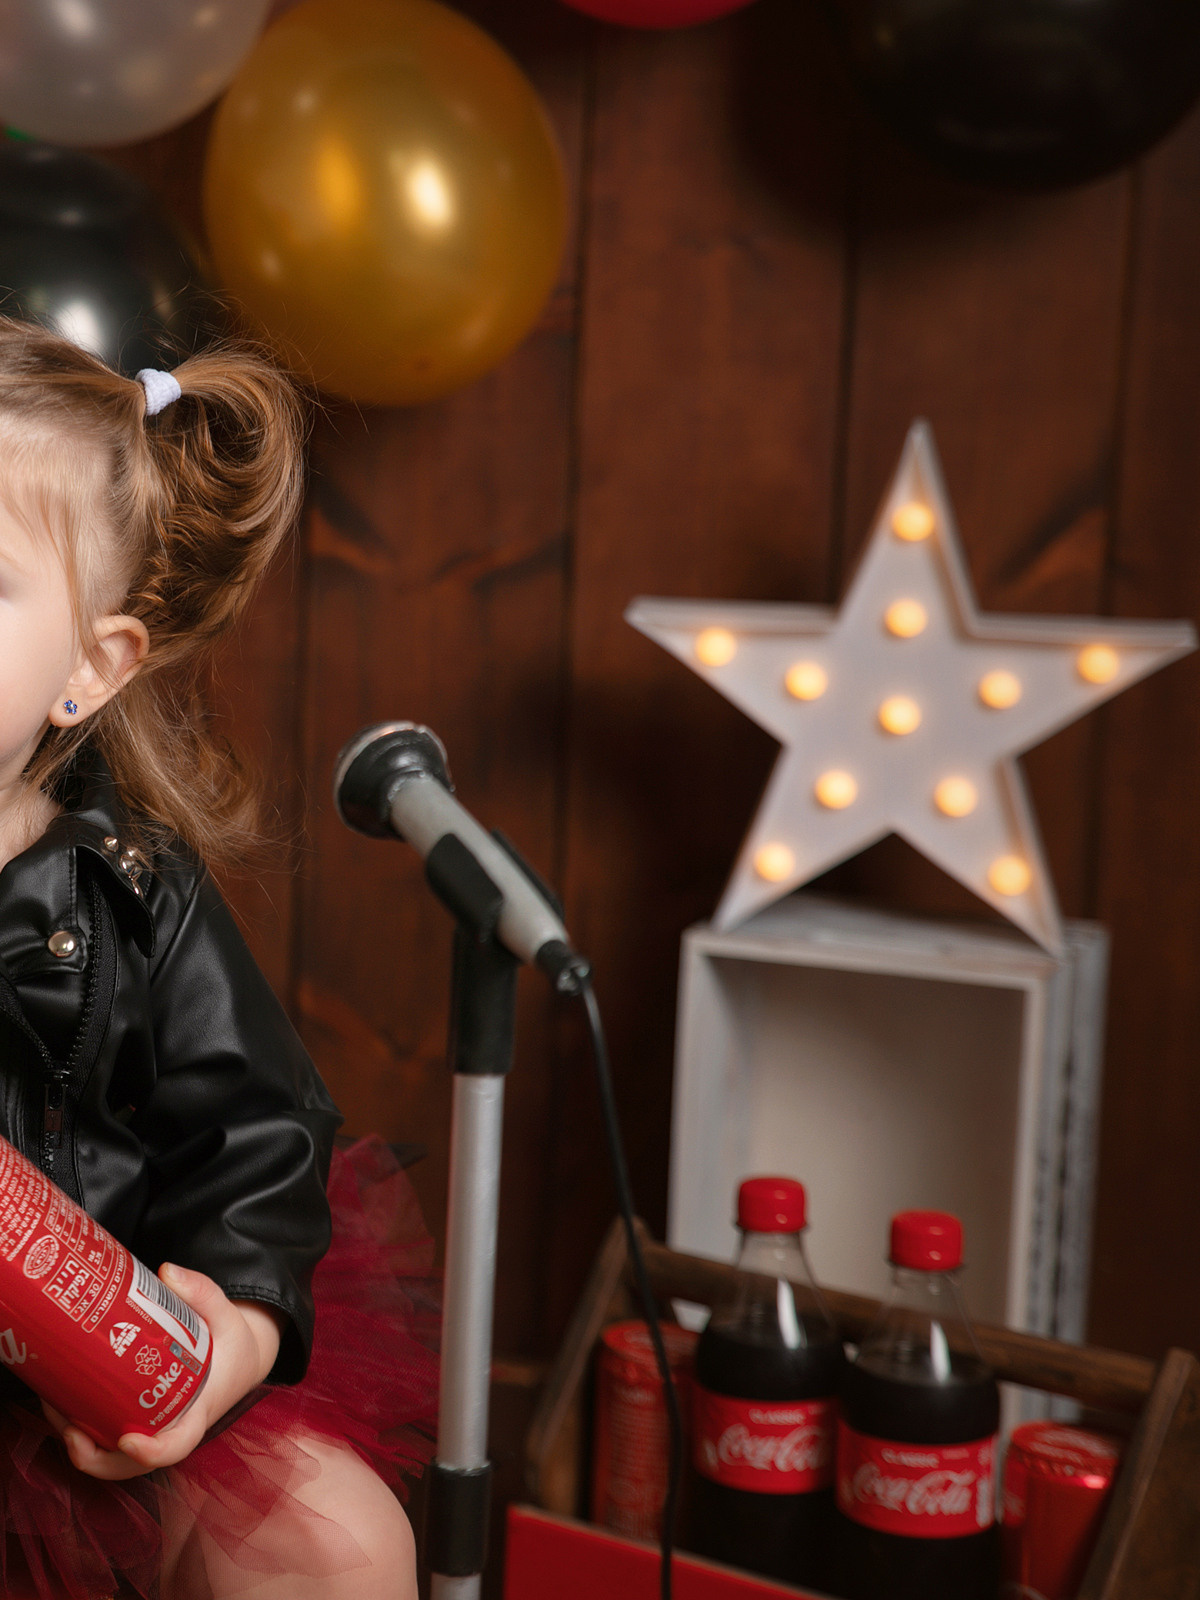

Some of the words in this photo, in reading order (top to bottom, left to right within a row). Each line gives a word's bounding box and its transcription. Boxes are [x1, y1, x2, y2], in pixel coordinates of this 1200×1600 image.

[47, 1257, 79, 1297] חייב
[58, 1267, 91, 1309] בפיקדון
[88, 1282, 100, 1297] 30
[89, 1283, 117, 1323] משמרים
[139, 1361, 183, 1409] Coke
